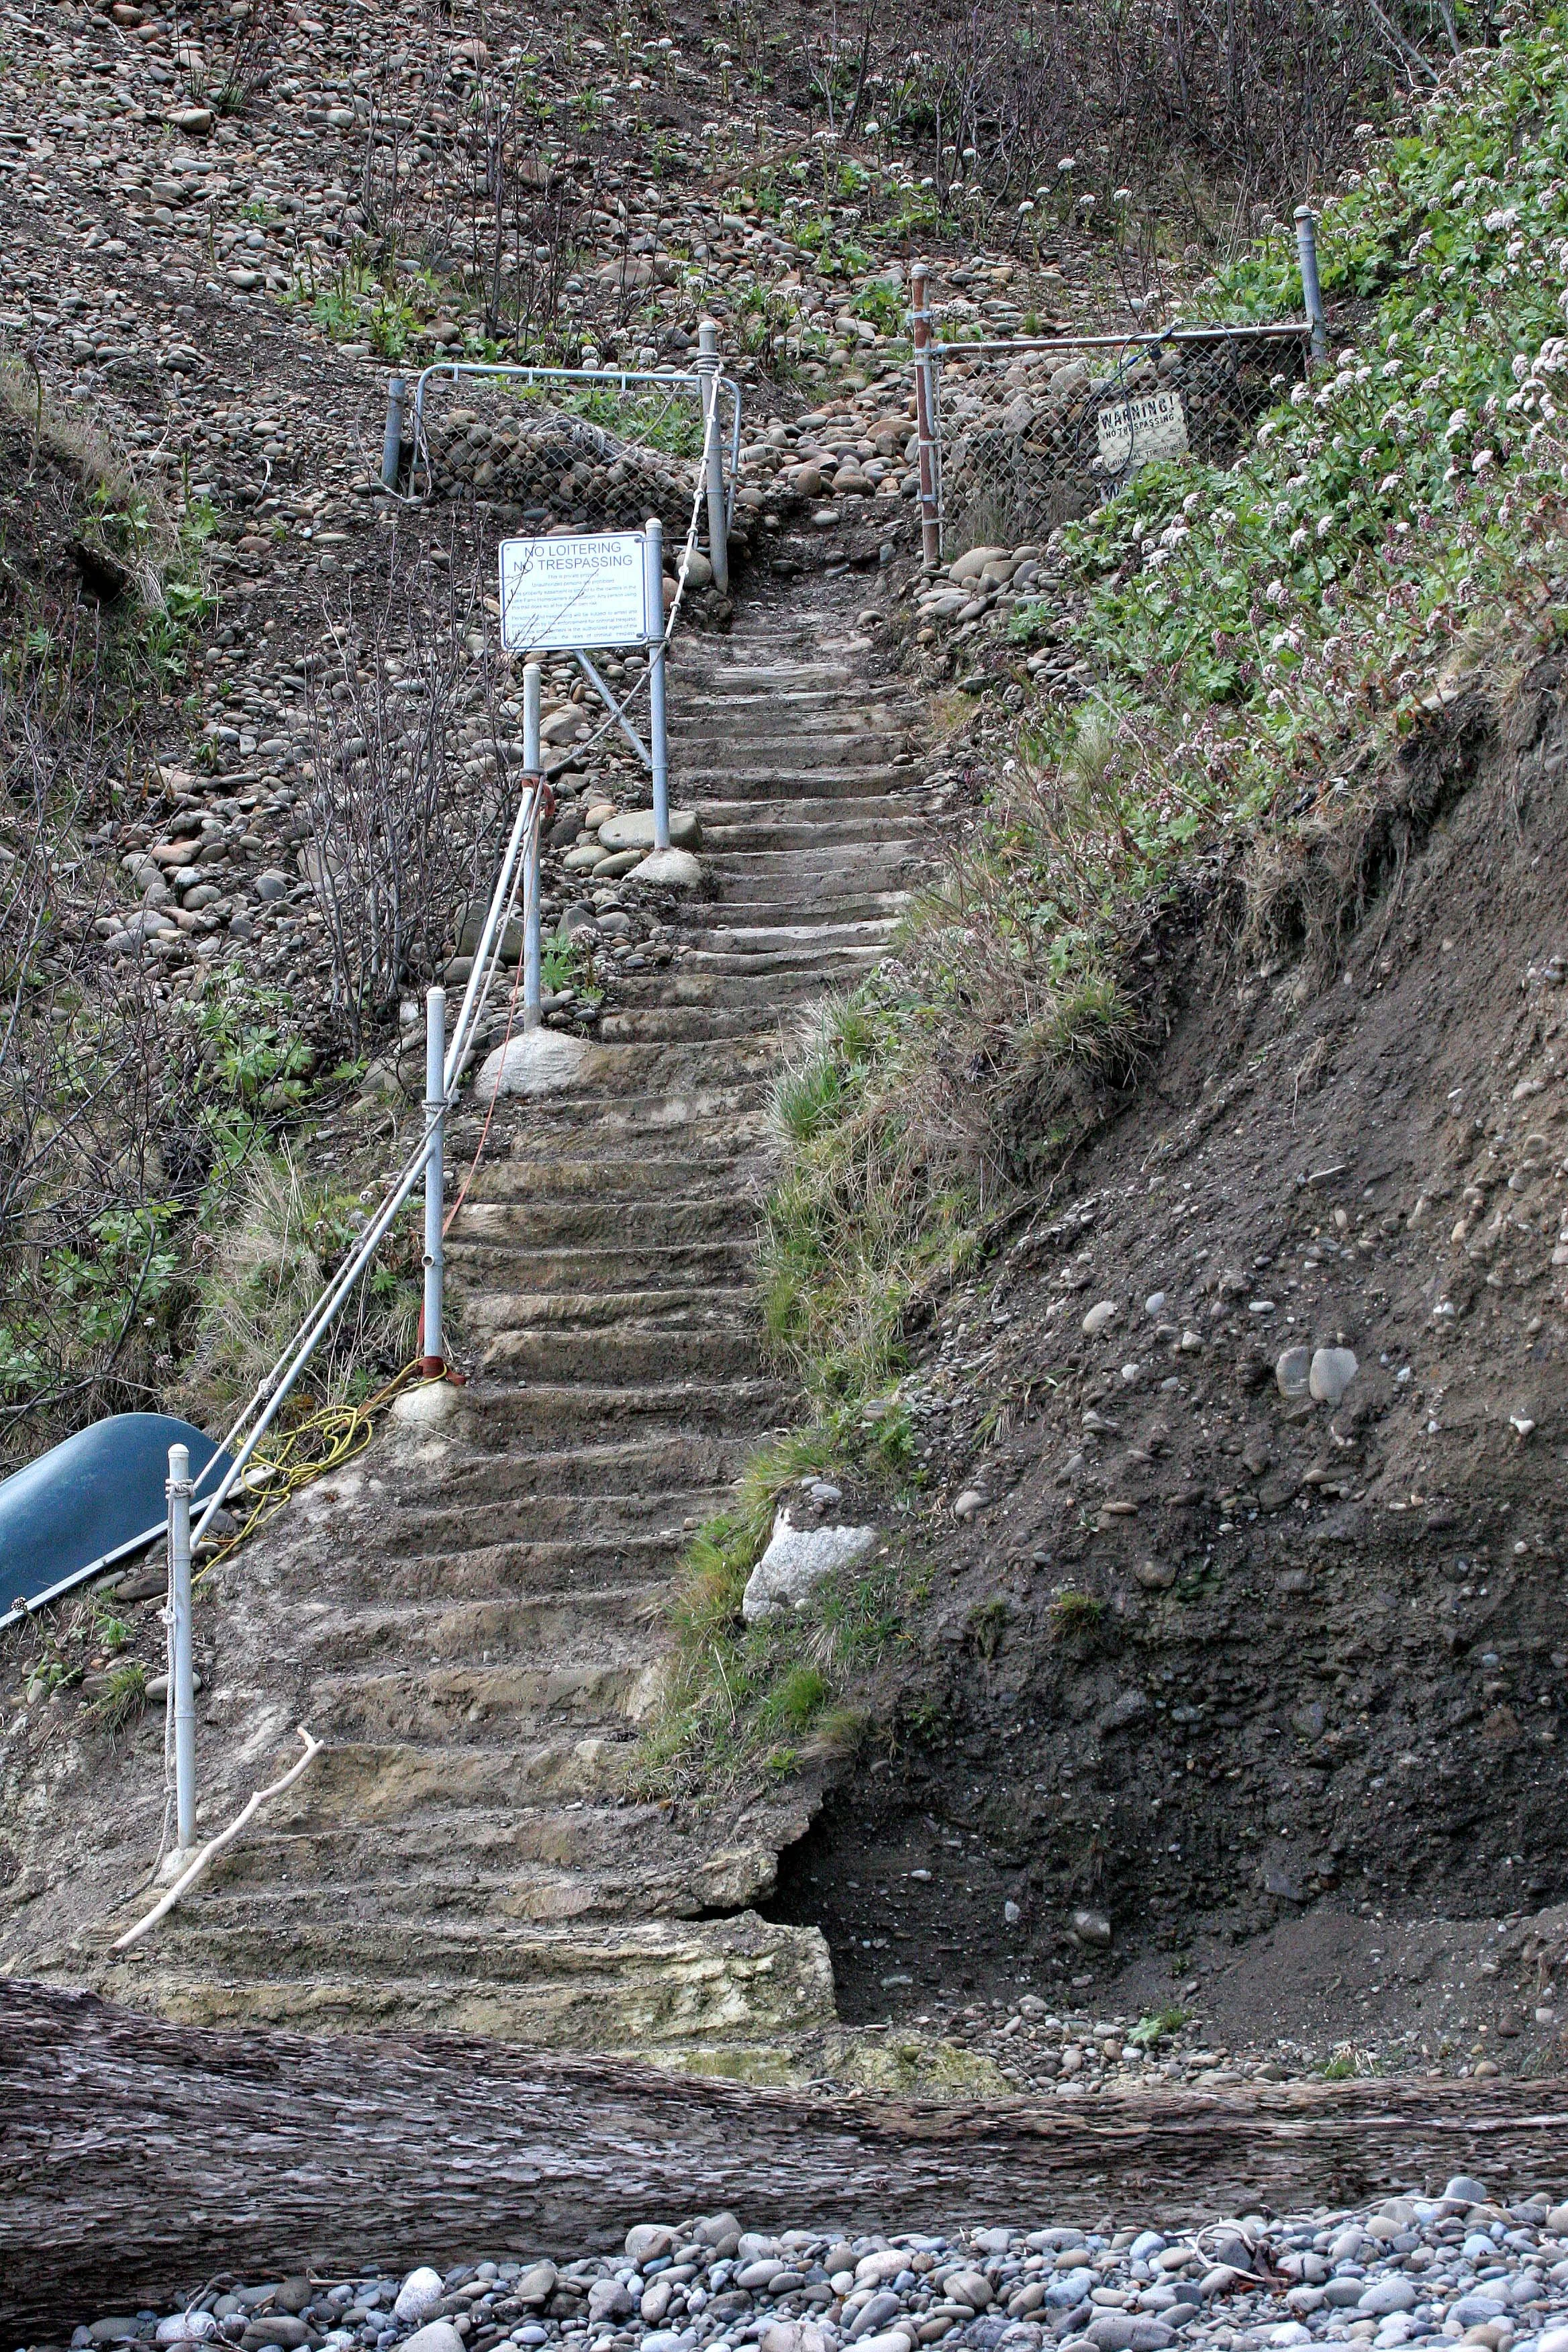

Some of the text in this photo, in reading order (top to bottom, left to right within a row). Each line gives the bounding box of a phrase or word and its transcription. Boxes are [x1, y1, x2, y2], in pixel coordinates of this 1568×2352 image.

[1100, 395, 1174, 430] WARNING!
[1106, 430, 1116, 439] NO
[1108, 454, 1144, 468] CRIMAL
[525, 542, 621, 558] NO LOITERING
[513, 554, 632, 572] NO TRESPASSING
